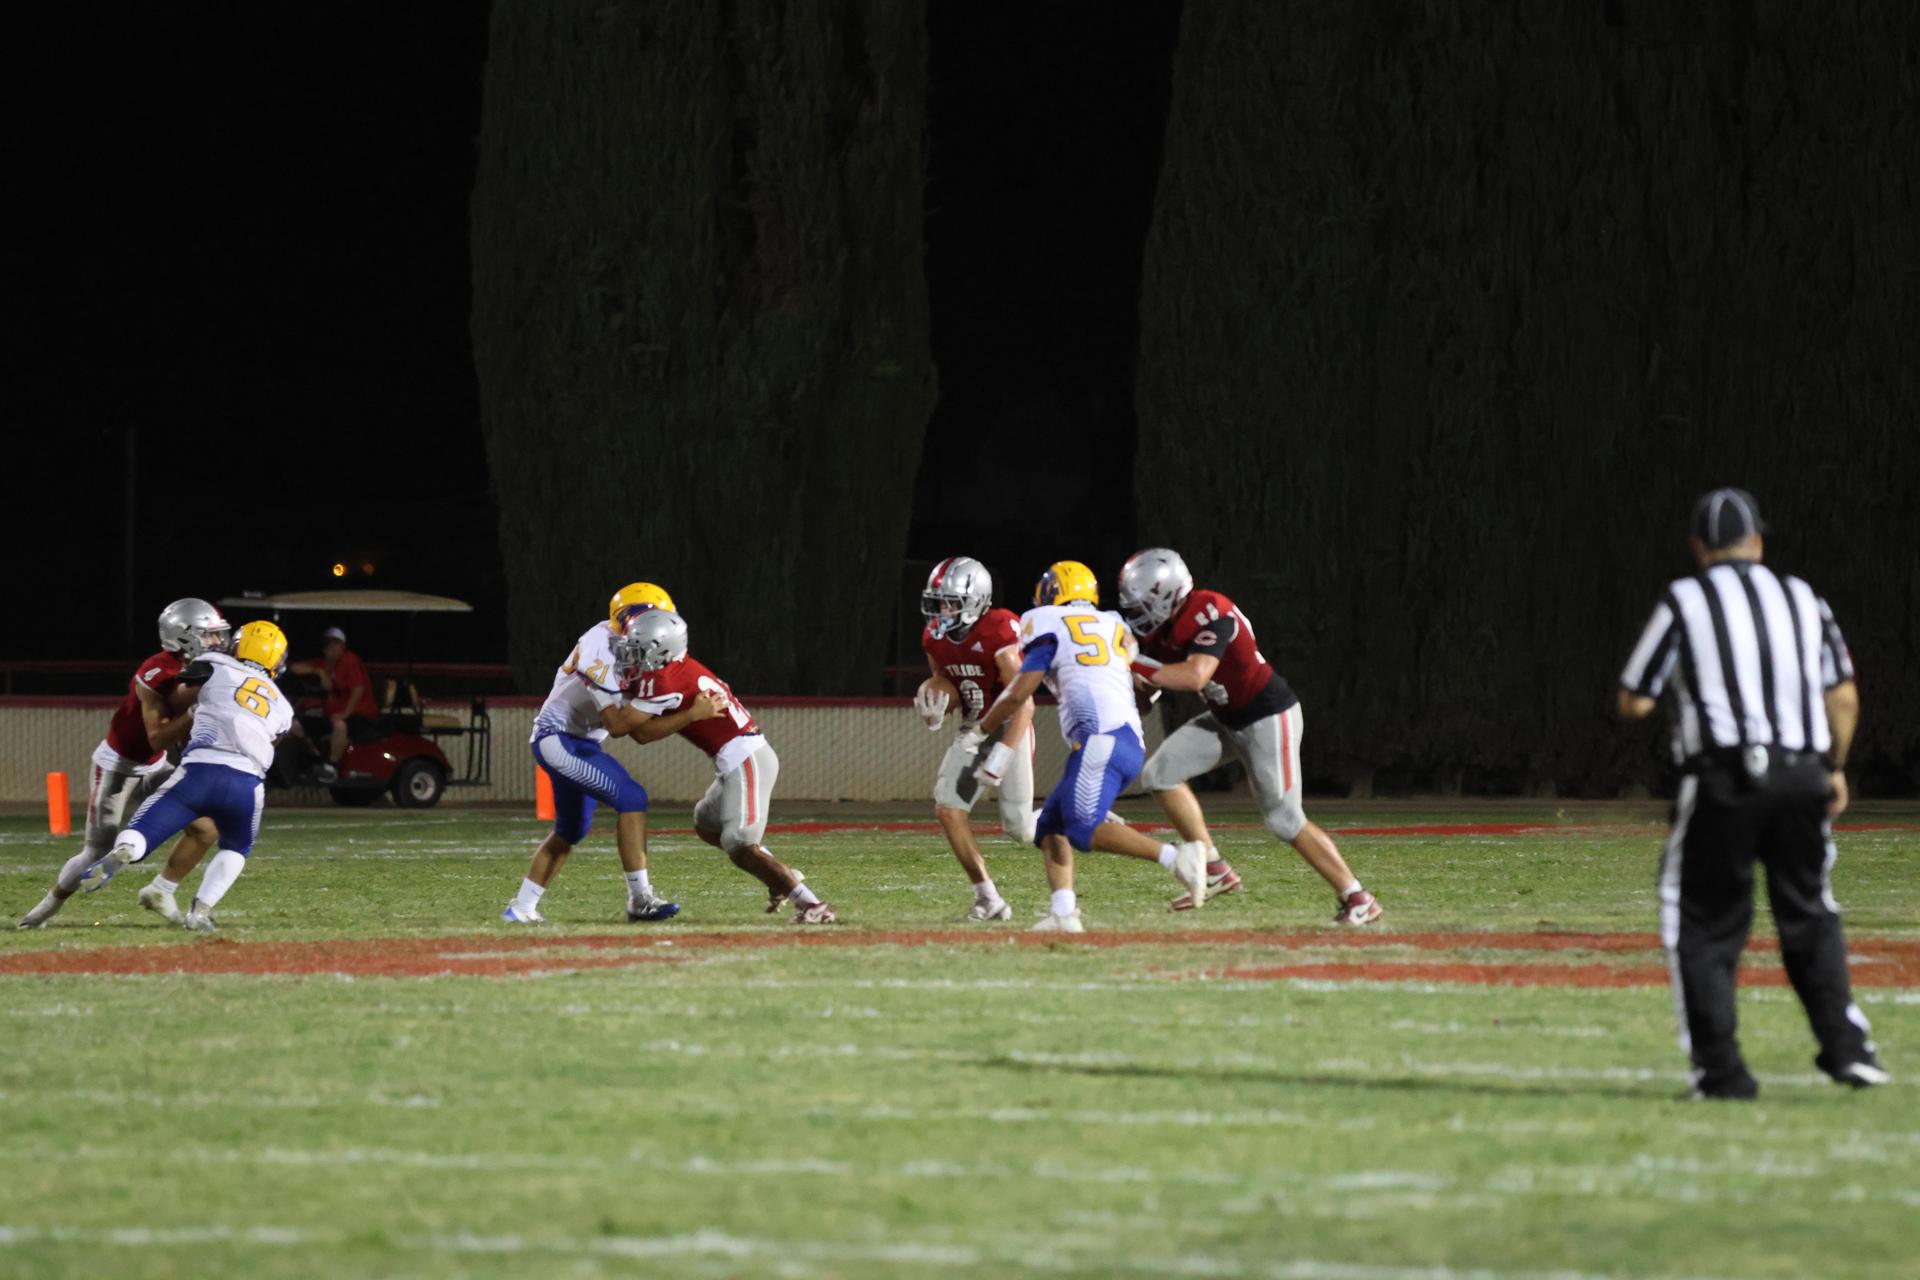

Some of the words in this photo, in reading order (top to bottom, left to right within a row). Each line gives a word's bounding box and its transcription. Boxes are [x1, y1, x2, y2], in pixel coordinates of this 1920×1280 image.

[586, 658, 609, 684] 21
[945, 663, 985, 677] TRIBE
[234, 676, 277, 719] 6
